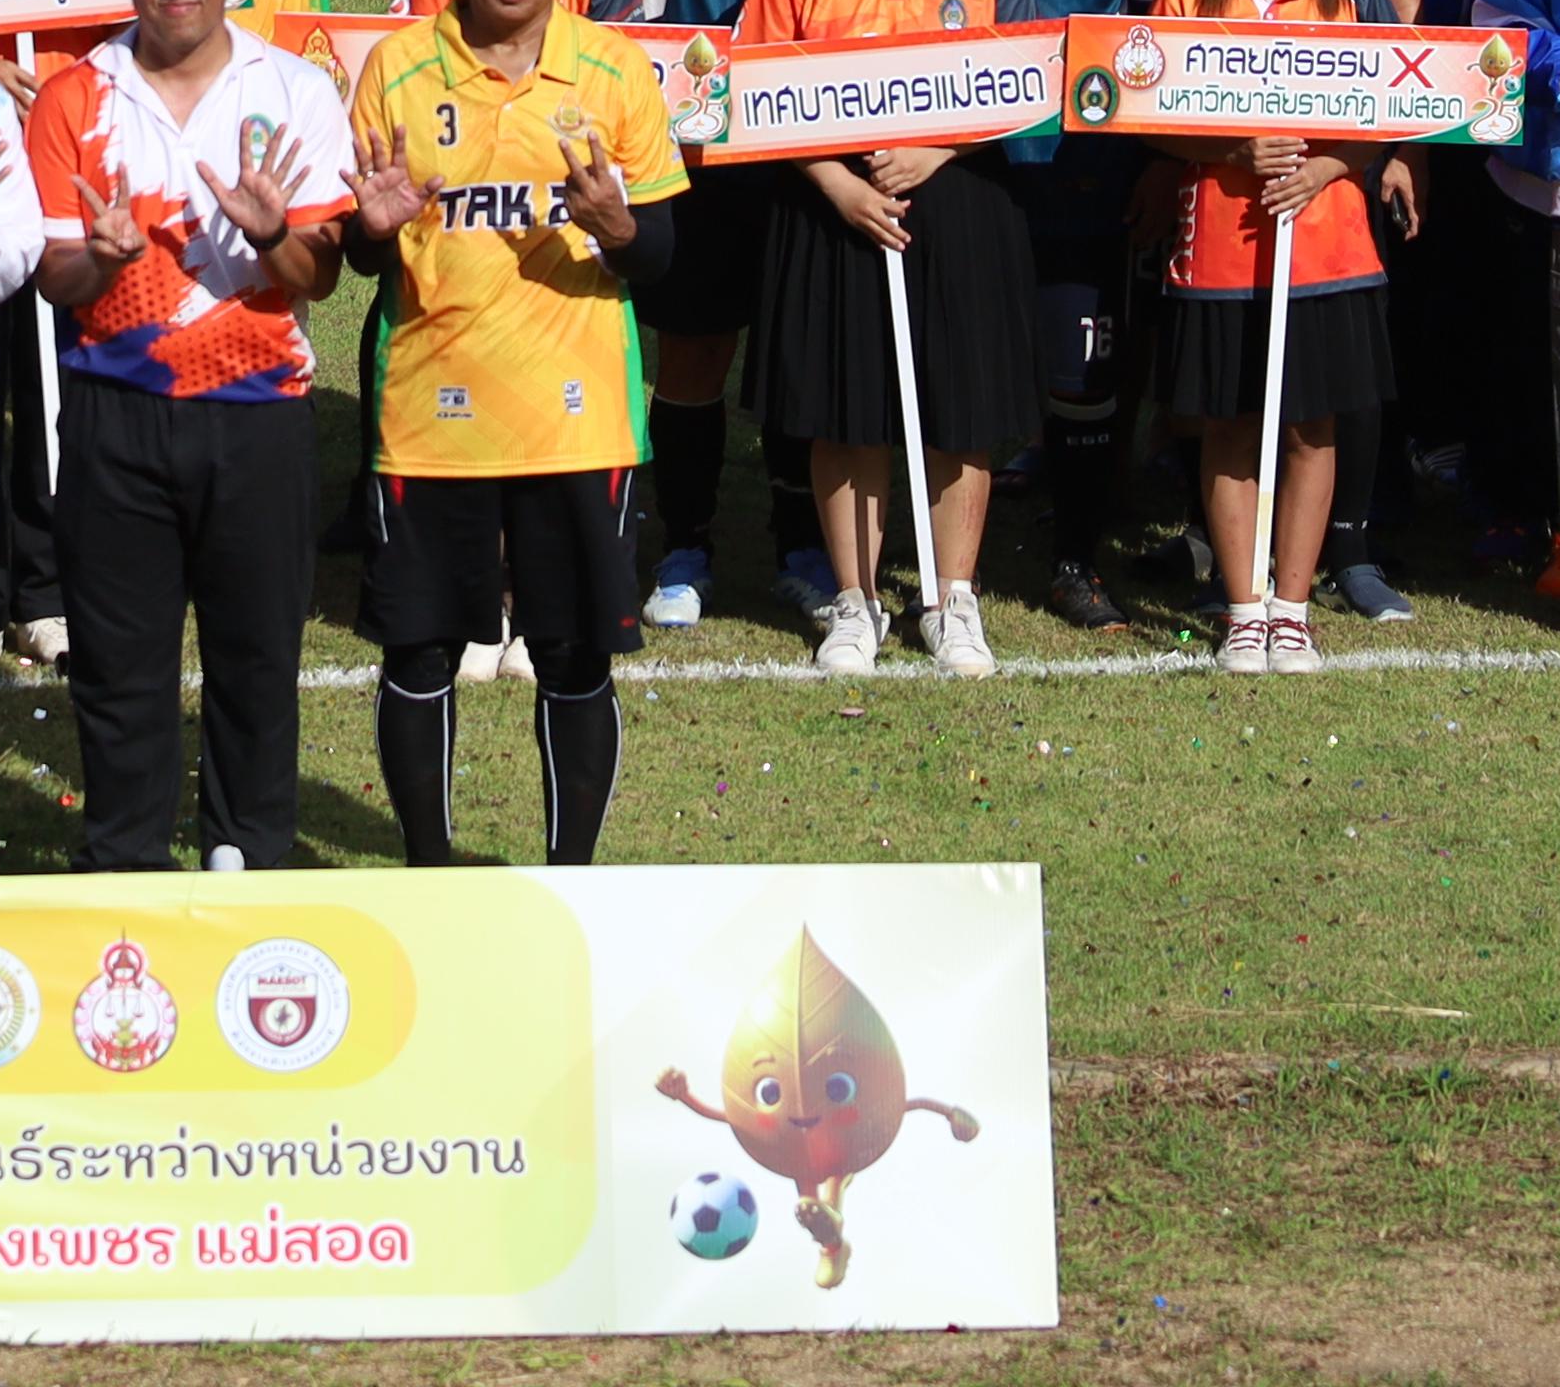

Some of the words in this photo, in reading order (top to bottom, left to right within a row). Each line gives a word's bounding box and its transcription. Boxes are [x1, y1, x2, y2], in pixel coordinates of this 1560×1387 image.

[1184, 41, 1381, 86] ศาลยุติธรรม
[742, 58, 1047, 128] เทศบาลนครแม่สอด
[1157, 82, 1377, 127] มหาวิทยาลัยราชภัฏ
[1387, 86, 1464, 121] แม่สอด
[435, 101, 461, 148] 3
[197, 1207, 410, 1266] แม่สอด
